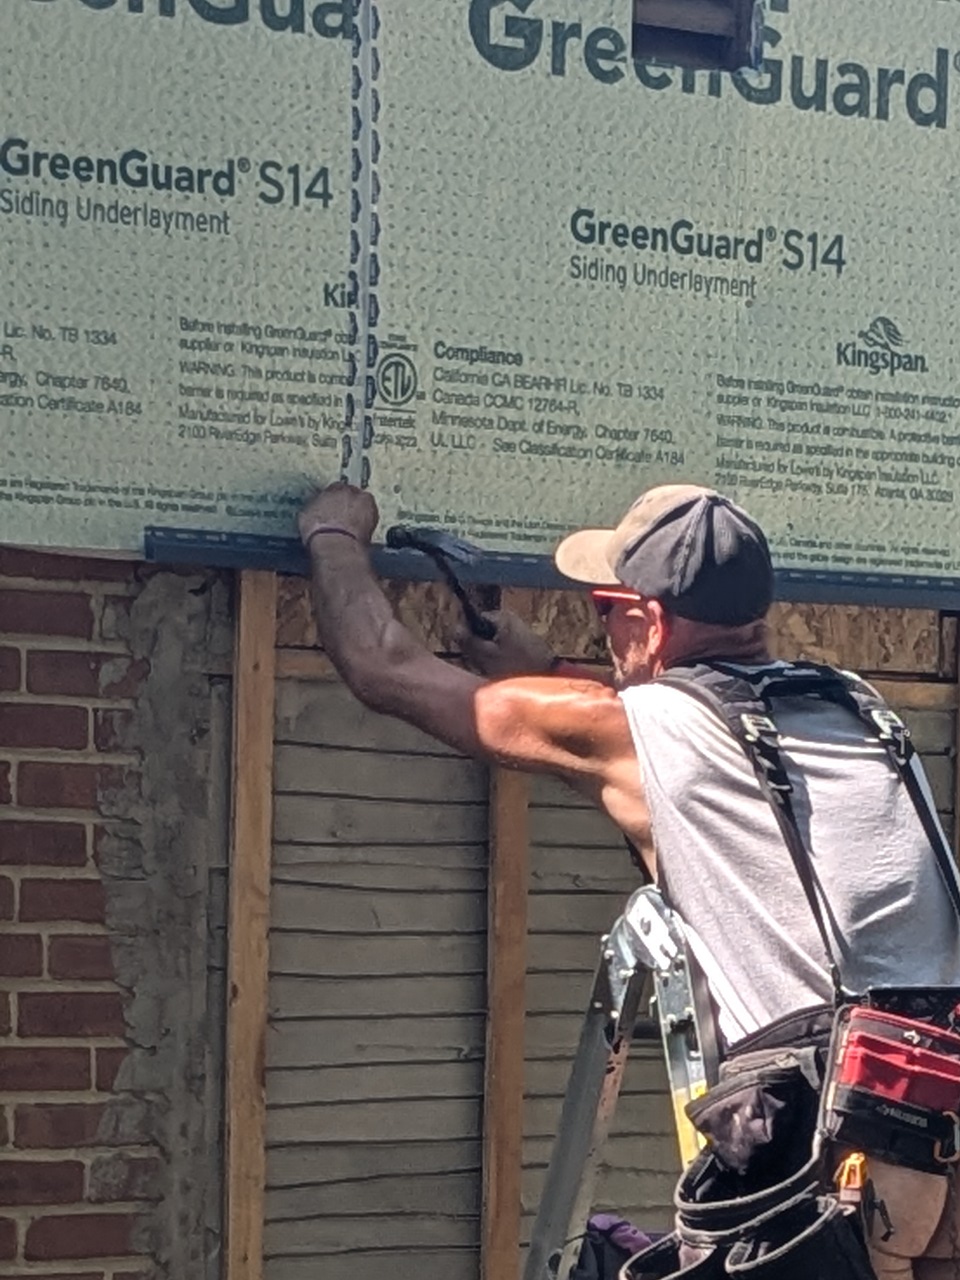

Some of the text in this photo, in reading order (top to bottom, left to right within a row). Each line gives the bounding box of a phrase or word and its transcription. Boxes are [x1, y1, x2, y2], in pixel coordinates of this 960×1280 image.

[258, 160, 334, 209] S14
[0, 188, 231, 237] Siding Underlayment
[782, 229, 847, 279] S14
[570, 255, 758, 300] Siding Underlayment
[84, 330, 117, 346] 1334
[434, 340, 523, 367] Compliance
[432, 387, 480, 407] Canada
[431, 409, 494, 431] Minnesota
